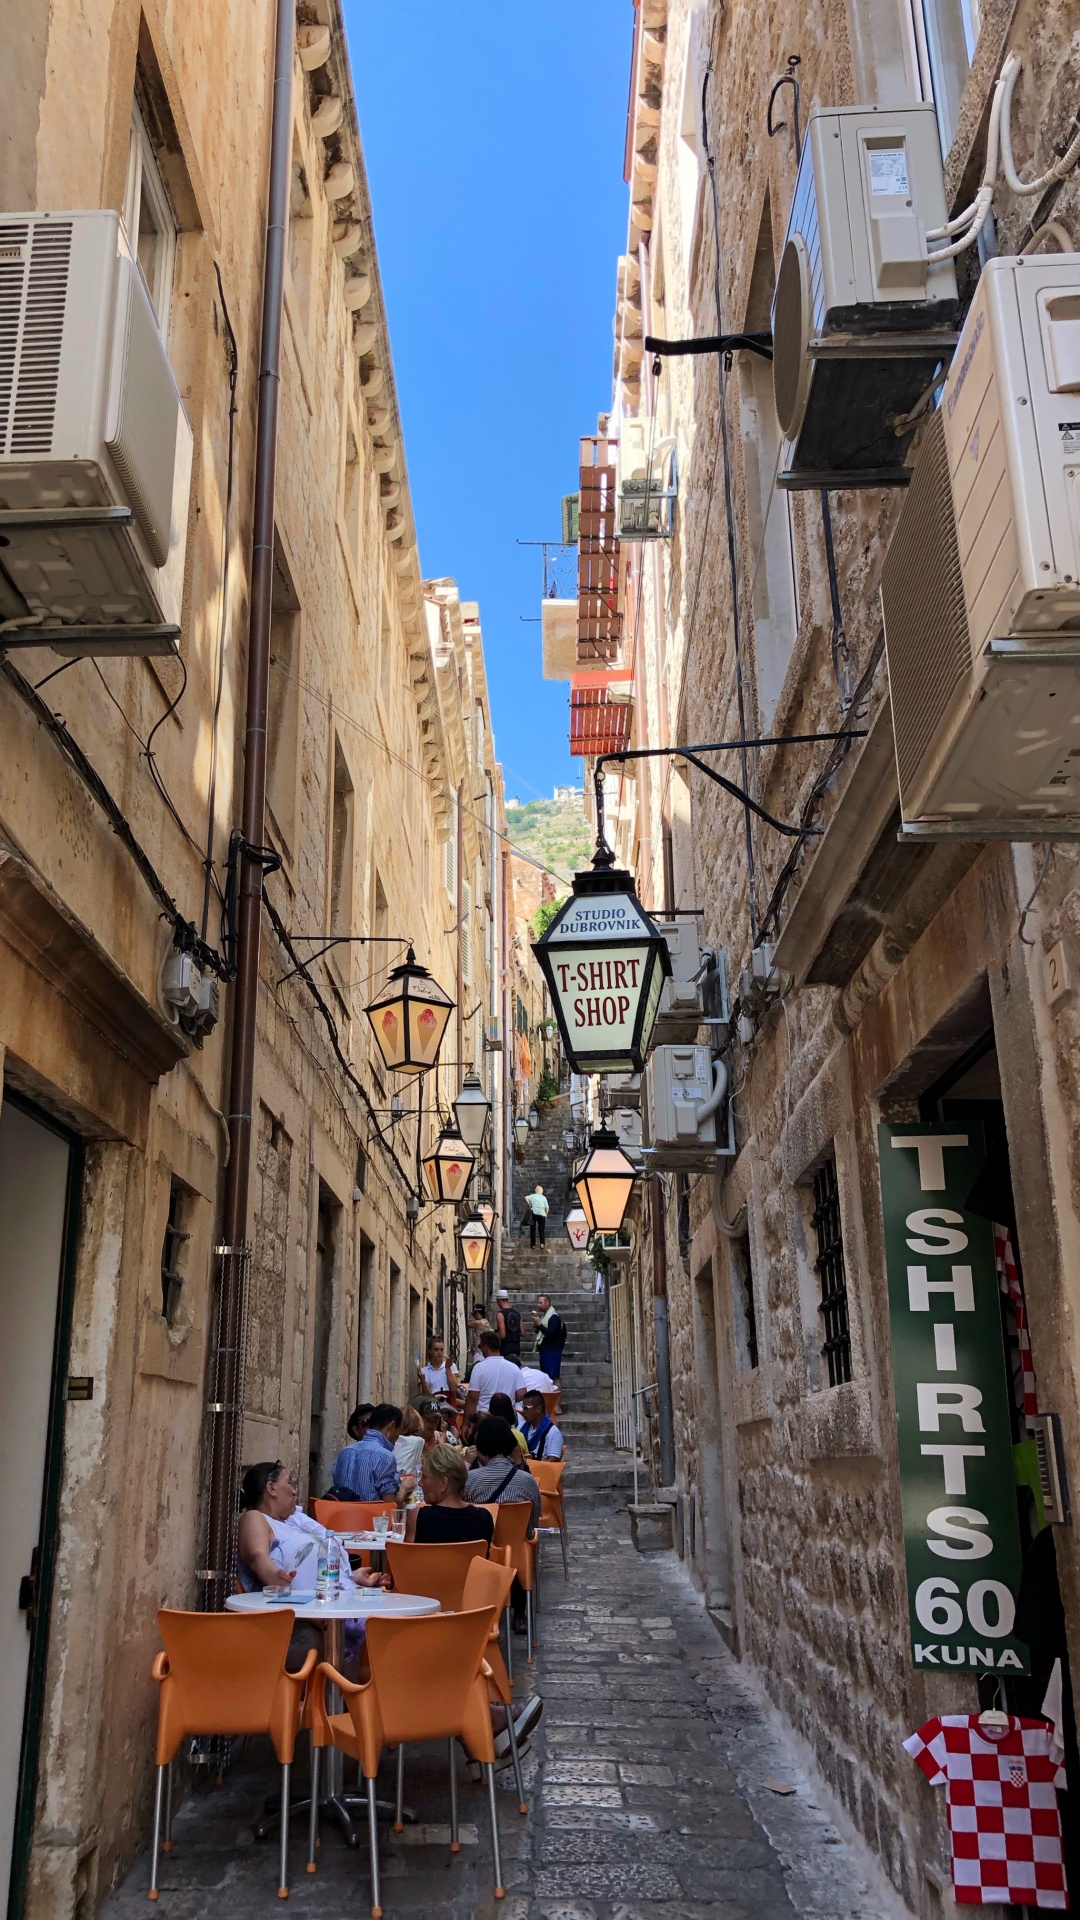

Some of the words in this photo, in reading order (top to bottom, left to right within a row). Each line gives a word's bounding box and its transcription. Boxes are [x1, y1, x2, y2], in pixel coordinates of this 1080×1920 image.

[560, 919, 641, 933] DUBROVNIK
[575, 908, 626, 921] STUDIO
[557, 958, 639, 993] T-SHIRT
[1048, 958, 1059, 991] 2
[573, 995, 630, 1027] SHOP
[914, 1577, 1016, 1639] 60
[914, 1643, 1025, 1669] KUNA
